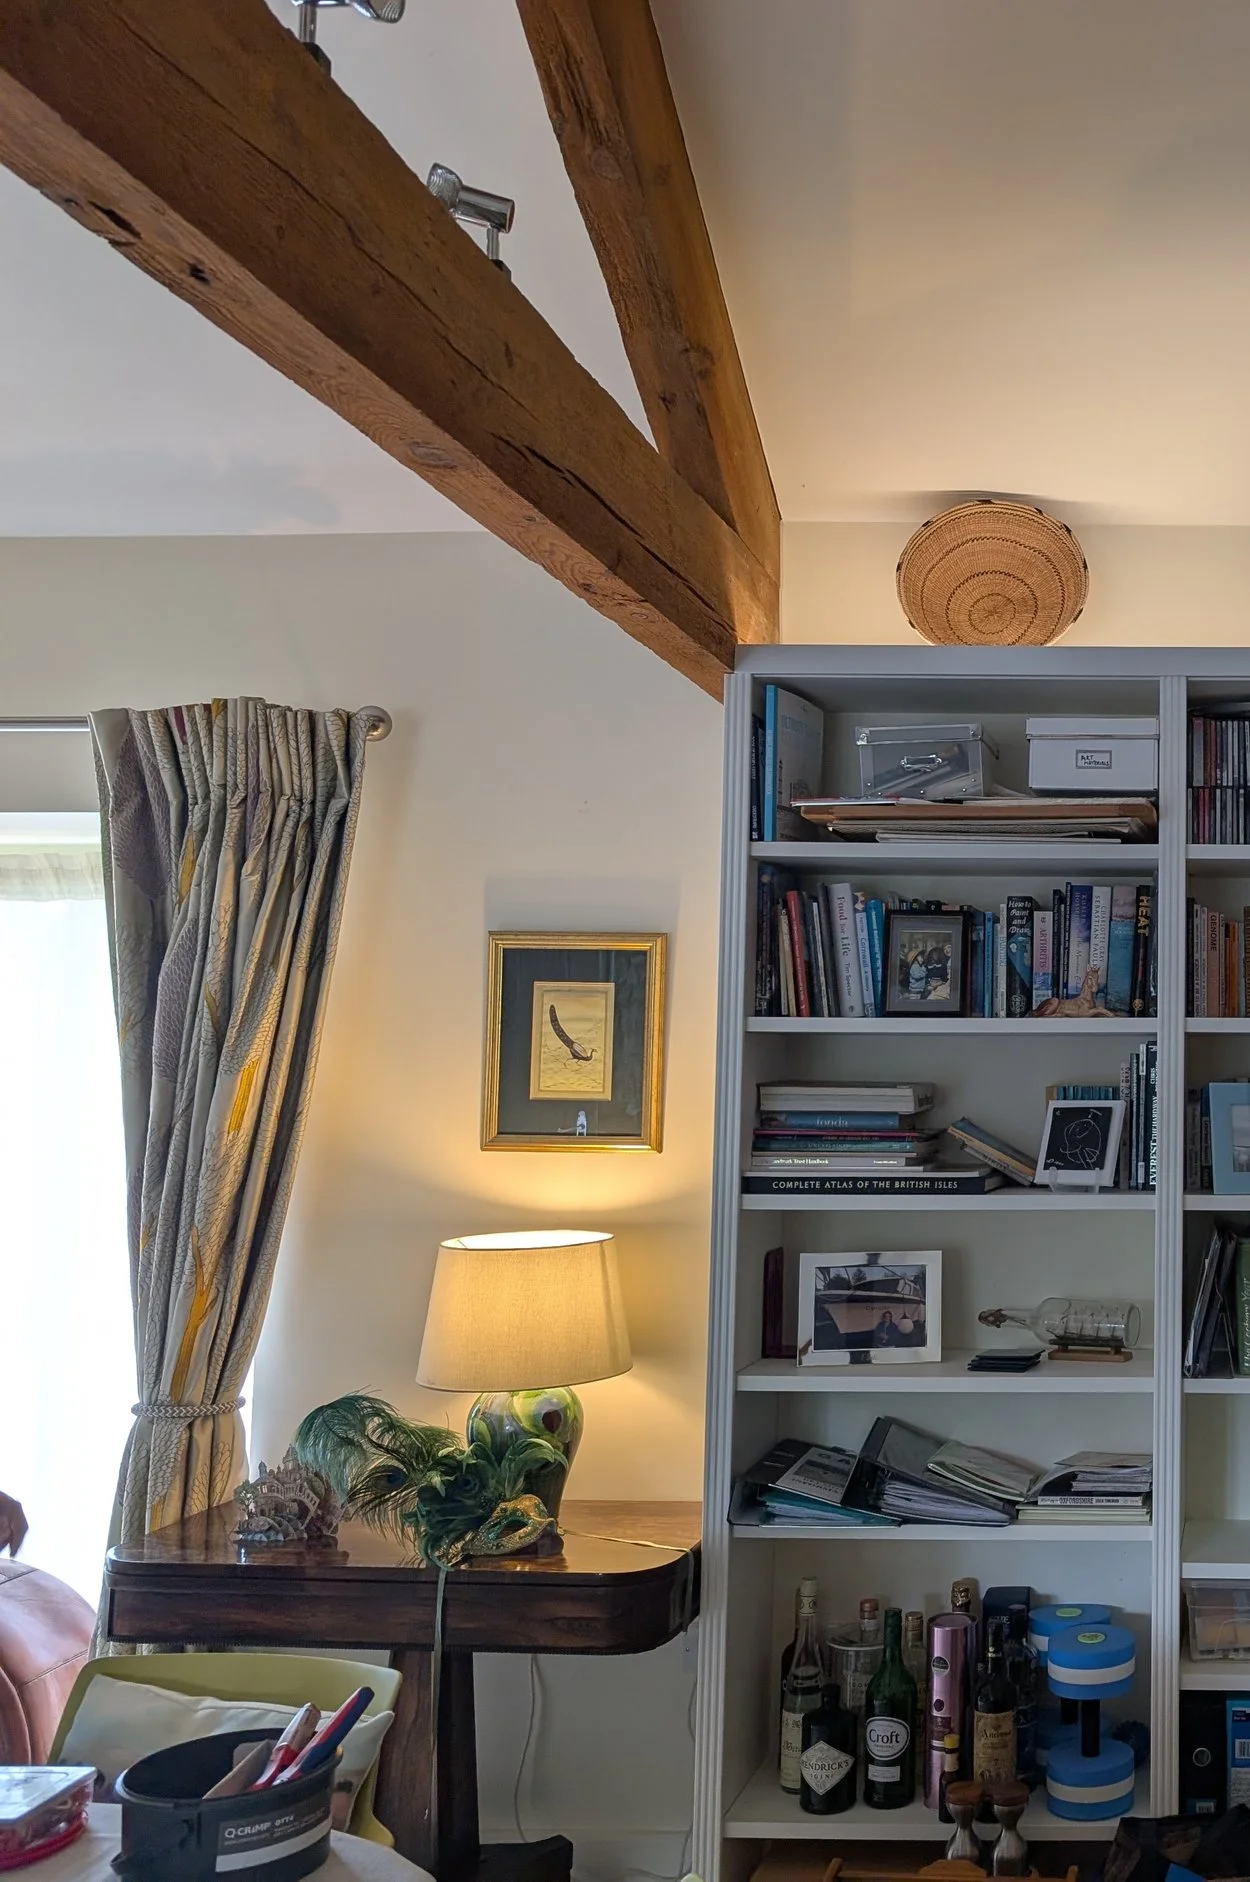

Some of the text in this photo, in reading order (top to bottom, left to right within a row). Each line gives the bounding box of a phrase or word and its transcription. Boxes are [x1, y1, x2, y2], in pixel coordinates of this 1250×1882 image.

[837, 897, 848, 921] Food
[1138, 895, 1151, 937] HEAT
[1012, 917, 1026, 925] and
[841, 936, 851, 957] Life
[1040, 928, 1049, 968] ARTHRITIS
[1149, 1141, 1157, 1186] EVEREST
[773, 1181, 958, 1189] COMPLETE ATLAS OF THE BRITISH ISLES
[869, 1729, 900, 1744] Croft
